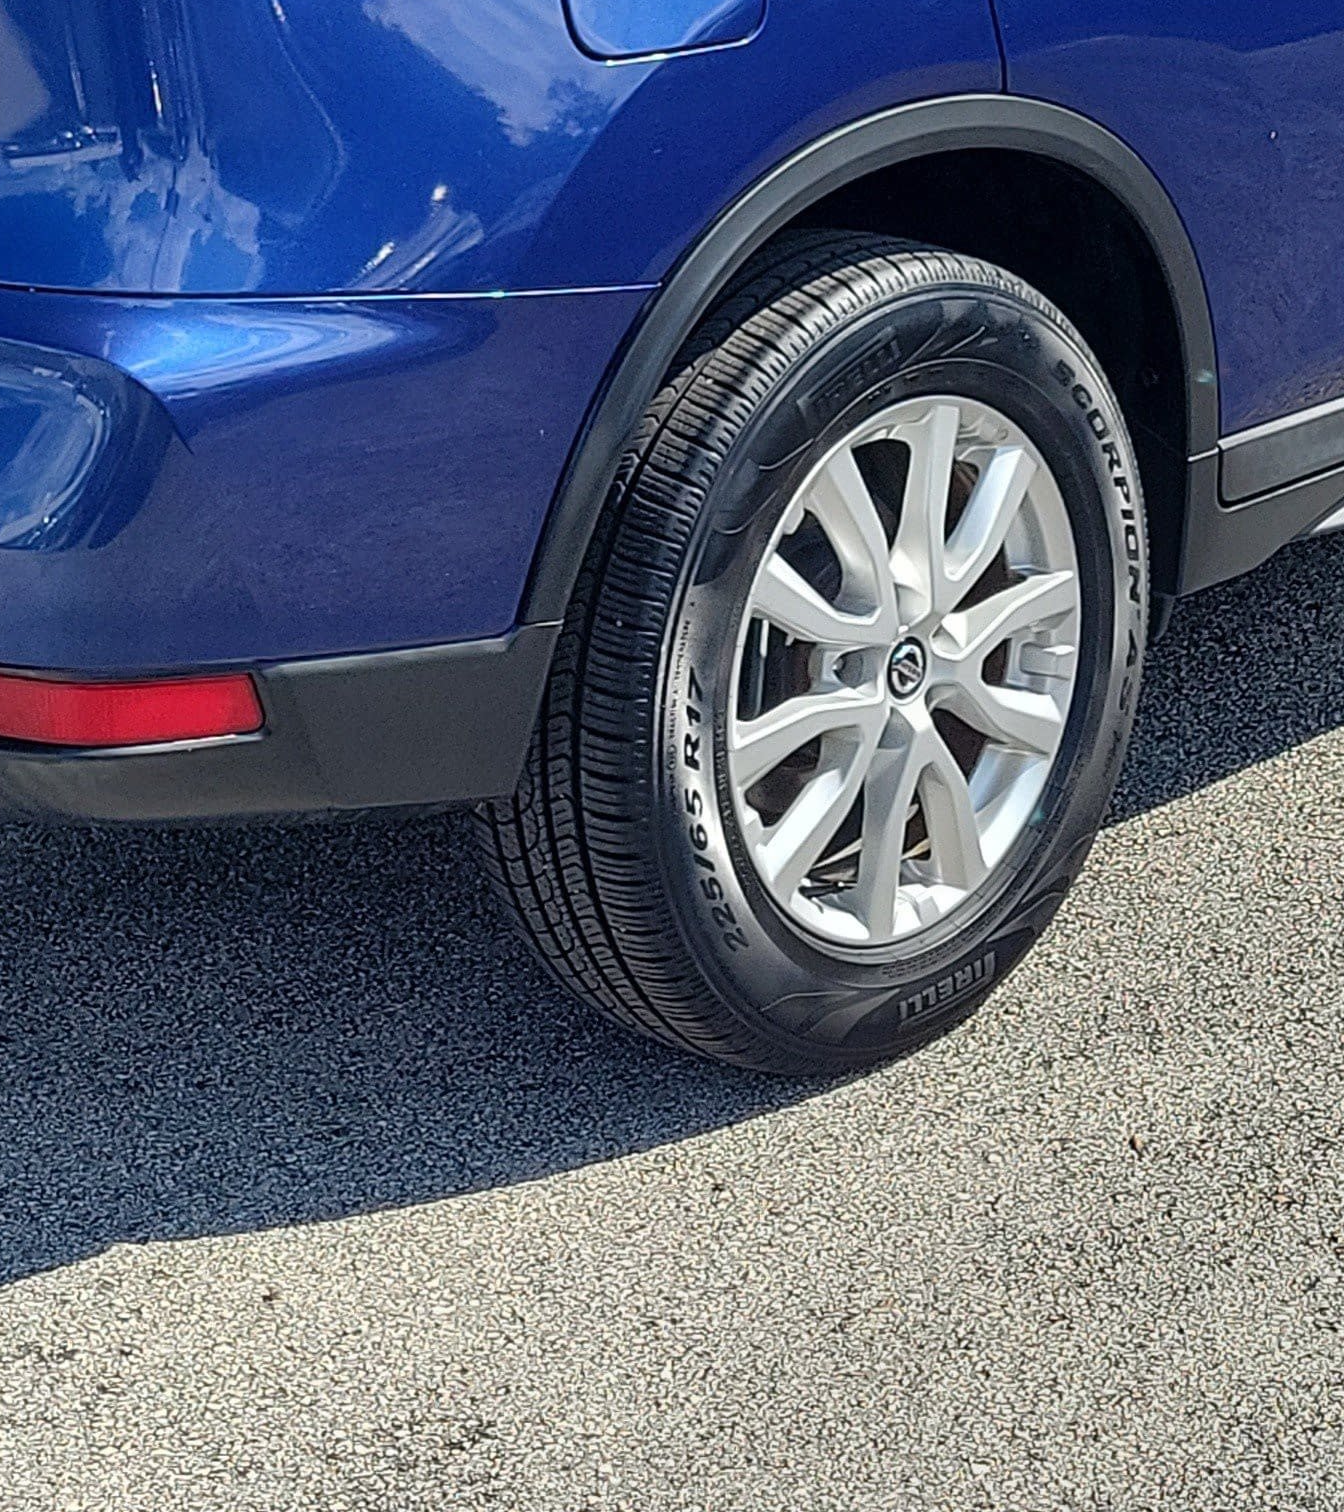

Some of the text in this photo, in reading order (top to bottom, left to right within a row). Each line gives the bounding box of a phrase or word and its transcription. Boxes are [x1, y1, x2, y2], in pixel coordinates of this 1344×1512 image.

[1054, 358, 1142, 605] SCORPION
[683, 665, 704, 772] R17
[685, 787, 749, 952] 225/65
[899, 950, 997, 1028] PIRELLI
